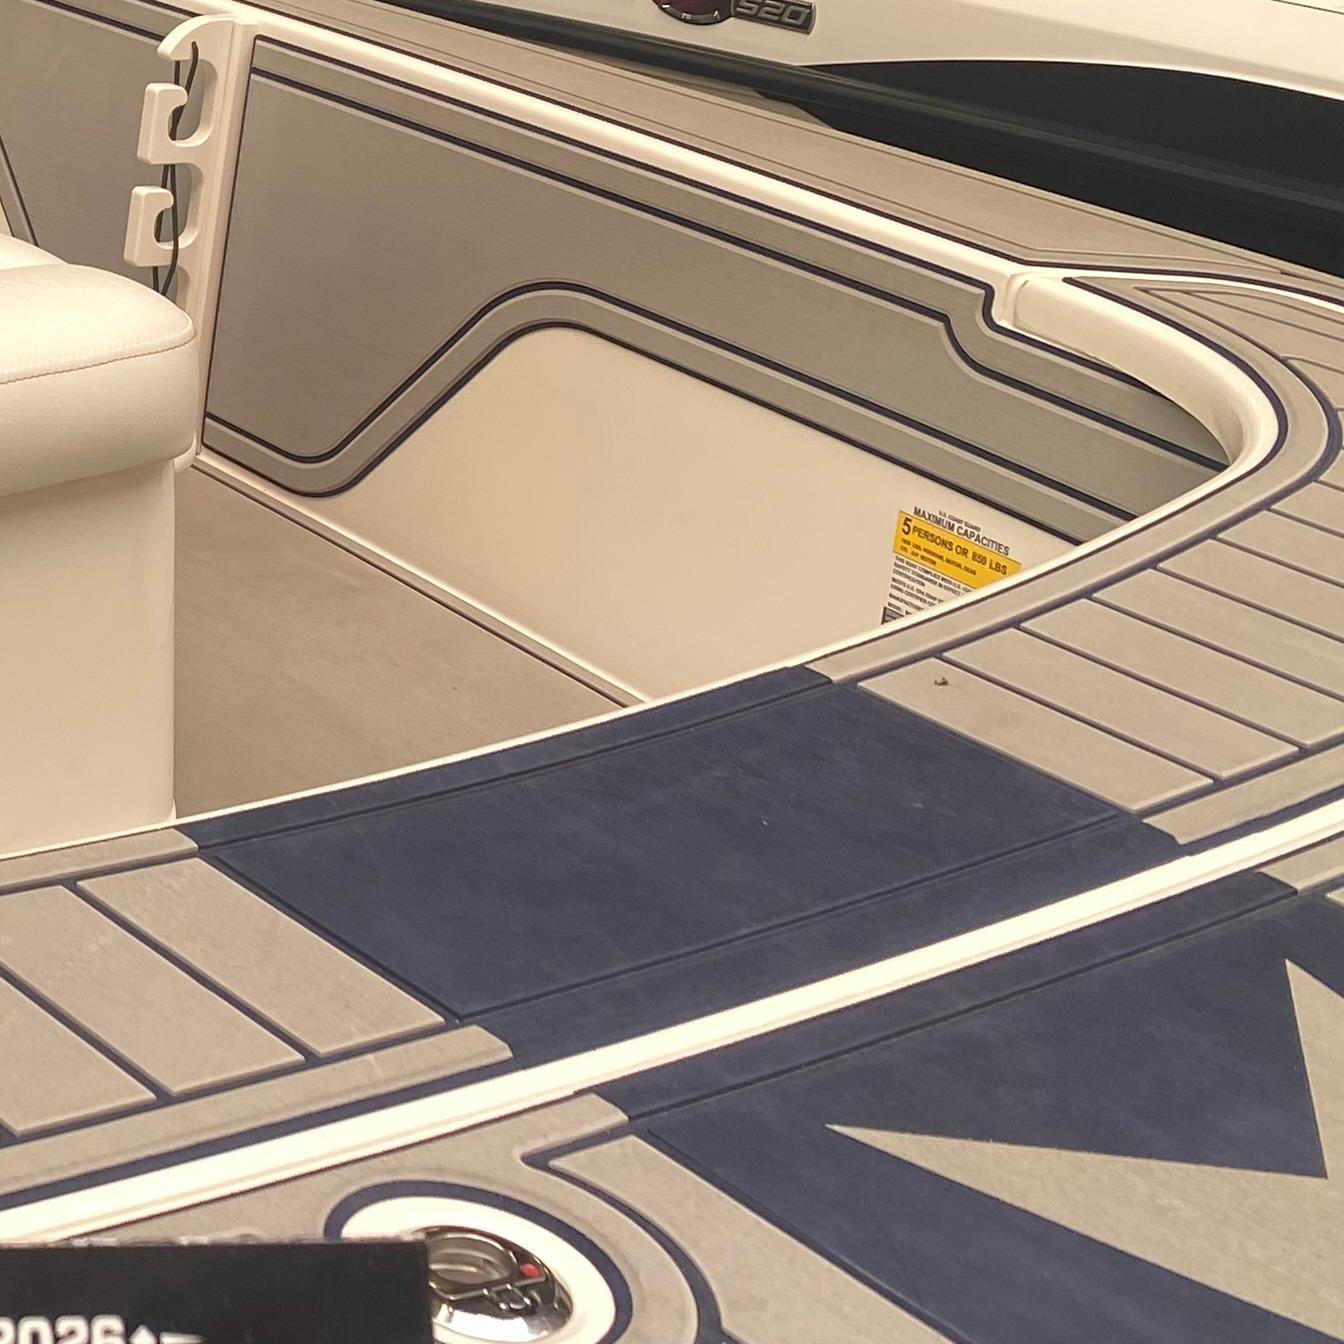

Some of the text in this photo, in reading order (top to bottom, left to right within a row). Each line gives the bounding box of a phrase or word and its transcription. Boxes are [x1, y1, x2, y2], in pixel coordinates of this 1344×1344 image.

[902, 517, 912, 535] 5
[912, 525, 954, 552] PERSONS
[955, 544, 969, 558] OR
[989, 558, 1008, 576] LBS
[913, 506, 1010, 556] MAXIMUM CAPACITIES
